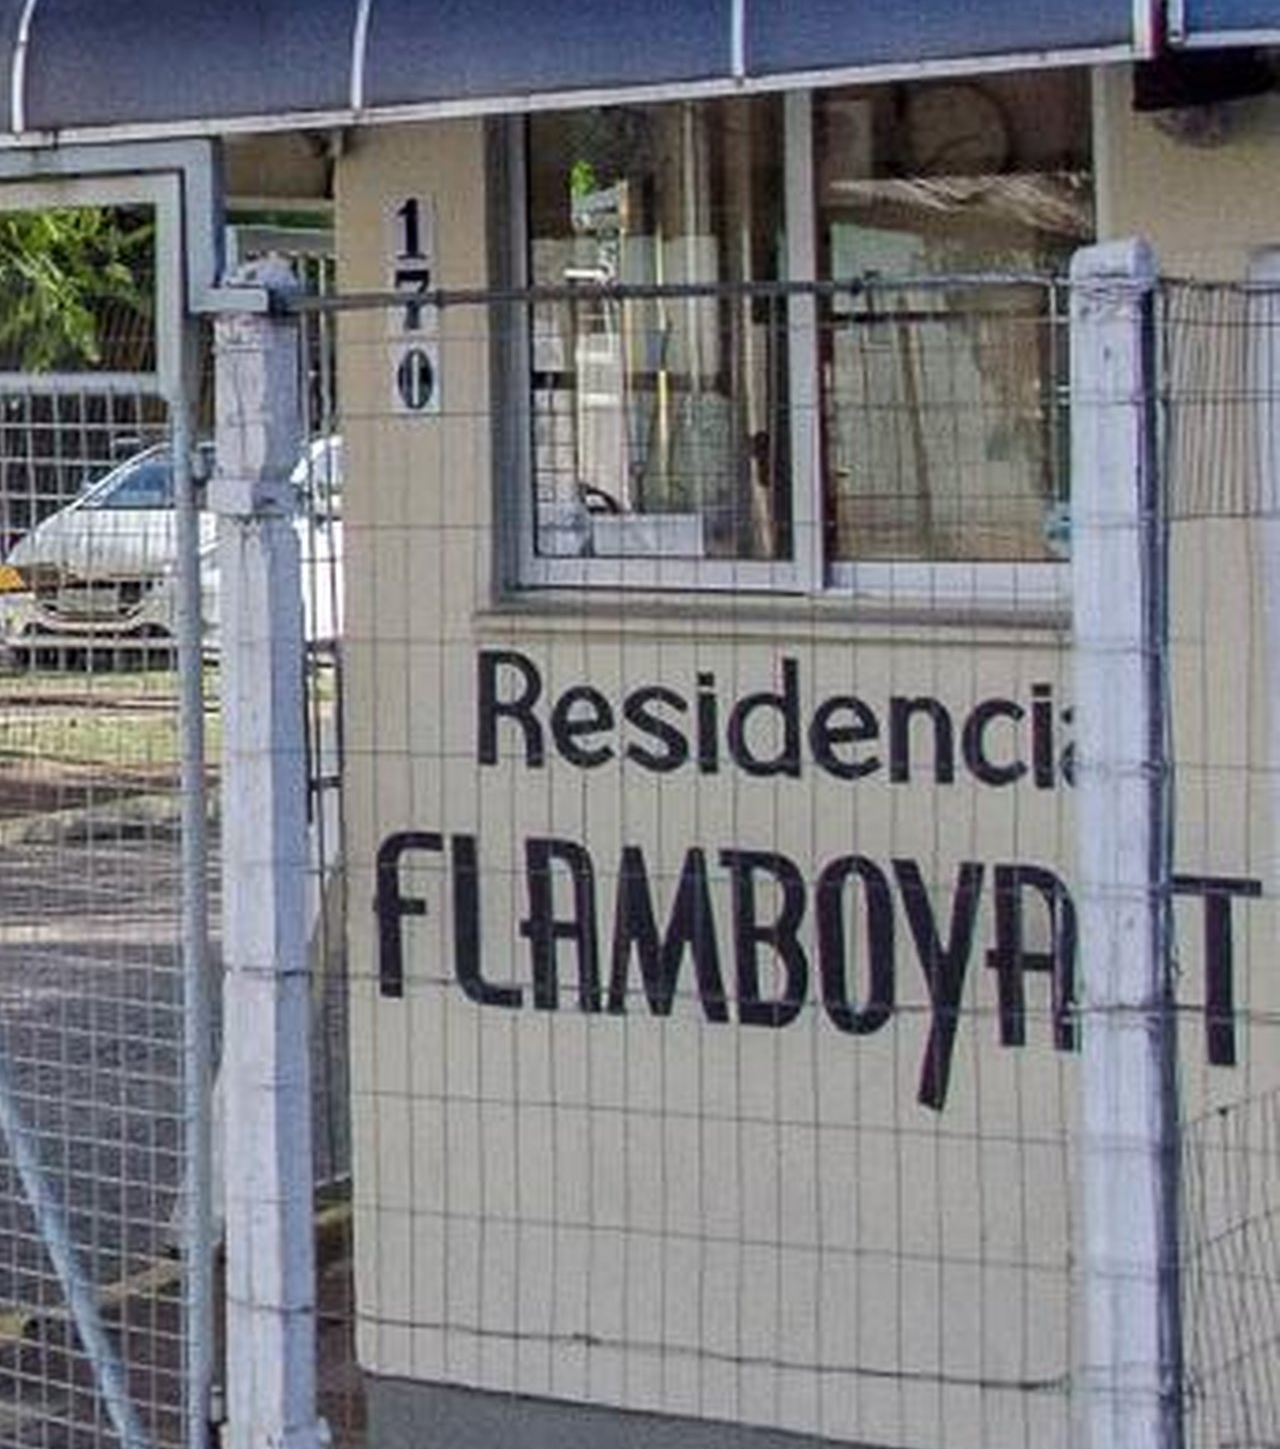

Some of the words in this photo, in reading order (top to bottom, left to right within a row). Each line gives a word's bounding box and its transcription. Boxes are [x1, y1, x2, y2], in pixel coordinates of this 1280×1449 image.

[394, 197, 434, 410] 170
[476, 650, 1077, 790] Residenci
[372, 831, 1262, 1112] FLAMBOYAT
